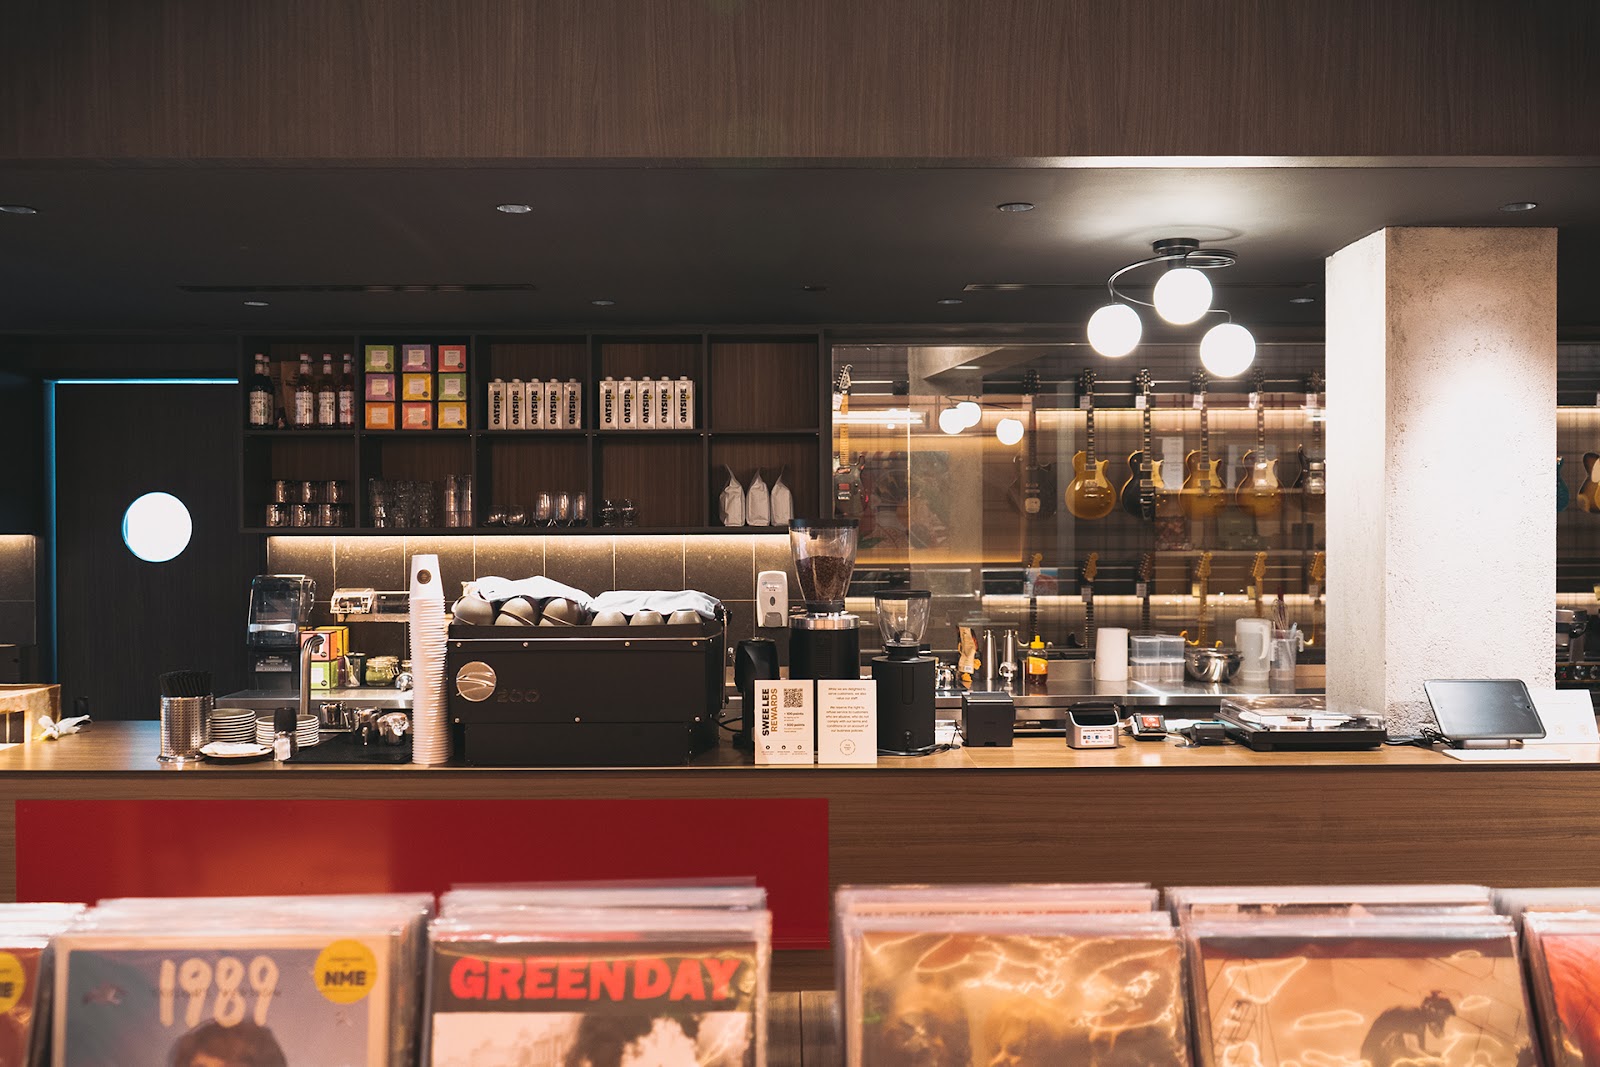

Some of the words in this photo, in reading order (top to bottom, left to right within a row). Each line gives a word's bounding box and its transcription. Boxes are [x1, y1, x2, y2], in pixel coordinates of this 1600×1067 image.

[762, 688, 770, 707] LEE
[762, 708, 770, 736] SWEE
[159, 956, 279, 1028] 1989
[325, 970, 366, 986] NME
[450, 957, 627, 1001] GREEN
[633, 958, 741, 1001] DAY
